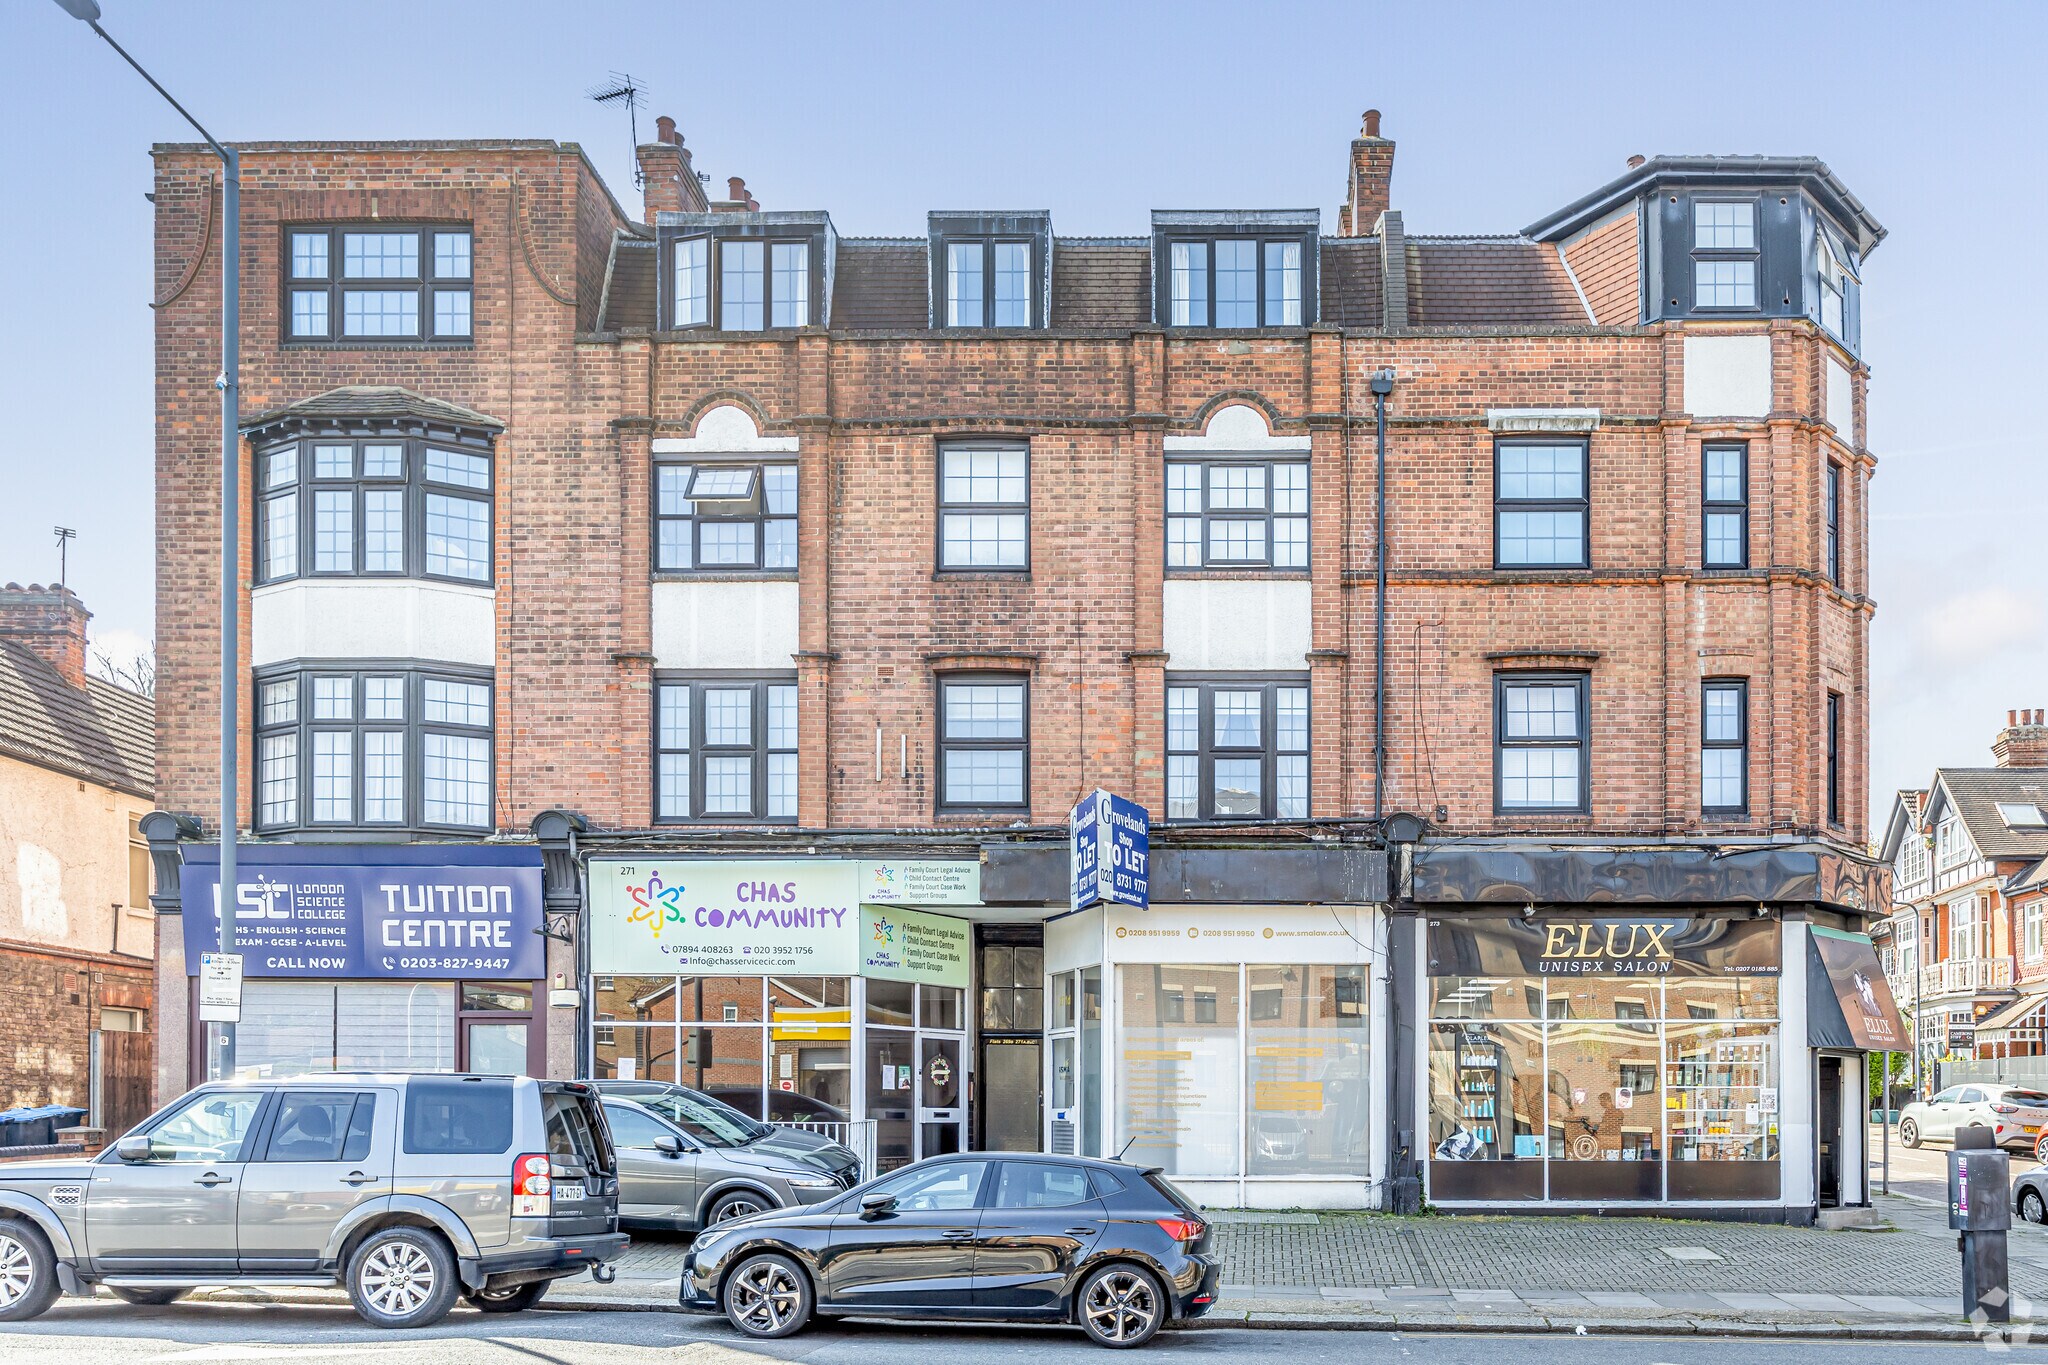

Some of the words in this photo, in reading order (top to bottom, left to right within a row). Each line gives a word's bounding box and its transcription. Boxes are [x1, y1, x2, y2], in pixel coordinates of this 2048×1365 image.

[1101, 798, 1146, 836] Grovelands
[1119, 831, 1133, 850] Shop
[1083, 842, 1096, 871] LET
[1104, 841, 1122, 867] TO
[1124, 847, 1146, 875] LET
[620, 866, 635, 876] 271
[908, 866, 925, 874] Family
[940, 866, 954, 874] Legal
[909, 883, 925, 891] Family
[1101, 868, 1113, 884] 020
[1116, 873, 1132, 892] 8731
[1134, 878, 1147, 894] 9777
[296, 884, 345, 894] LONDON
[736, 881, 797, 903] CHAS
[909, 891, 929, 899] Support
[297, 897, 346, 907] SCIENCE
[380, 884, 513, 914] TUITION
[297, 909, 346, 919] COLLEGE
[694, 906, 847, 929] COMMUNITY
[215, 926, 249, 934] MHS
[256, 926, 298, 934] ENGLISH
[305, 926, 346, 935] SCIENCE
[382, 919, 512, 948] CENTRE
[907, 923, 923, 936] Family
[922, 925, 936, 935] Court
[936, 928, 949, 939] Legal
[949, 931, 965, 940] Advice
[1128, 929, 1147, 937] 0208
[235, 938, 263, 946] EXAM
[270, 938, 297, 947] GCSE
[305, 939, 347, 947] A-LEVEL
[907, 935, 920, 944] Child
[920, 937, 939, 947] Contact
[939, 940, 955, 950] Centre
[1541, 923, 1675, 959] ELUX
[672, 945, 699, 953] 07894
[701, 945, 734, 954] 408263
[754, 946, 770, 954] 020
[772, 946, 793, 955] 3952
[795, 946, 814, 955] 1756
[876, 951, 890, 960] CHAS
[907, 946, 922, 959] Family
[922, 949, 936, 958] Court
[936, 951, 948, 961] Case
[948, 953, 960, 962] Work
[203, 955, 210, 964] P
[266, 957, 306, 969] CALL
[309, 957, 346, 969] NOW
[400, 957, 510, 969] 0203-827-9447
[689, 957, 796, 966] Info@chasservicecic.com
[866, 959, 901, 969] COMMUNITY
[907, 958, 926, 971] Support
[926, 961, 943, 972] Groups
[1539, 961, 1604, 973] UNISEX
[1613, 961, 1671, 973] SALON
[1863, 1017, 1893, 1035] ELUX
